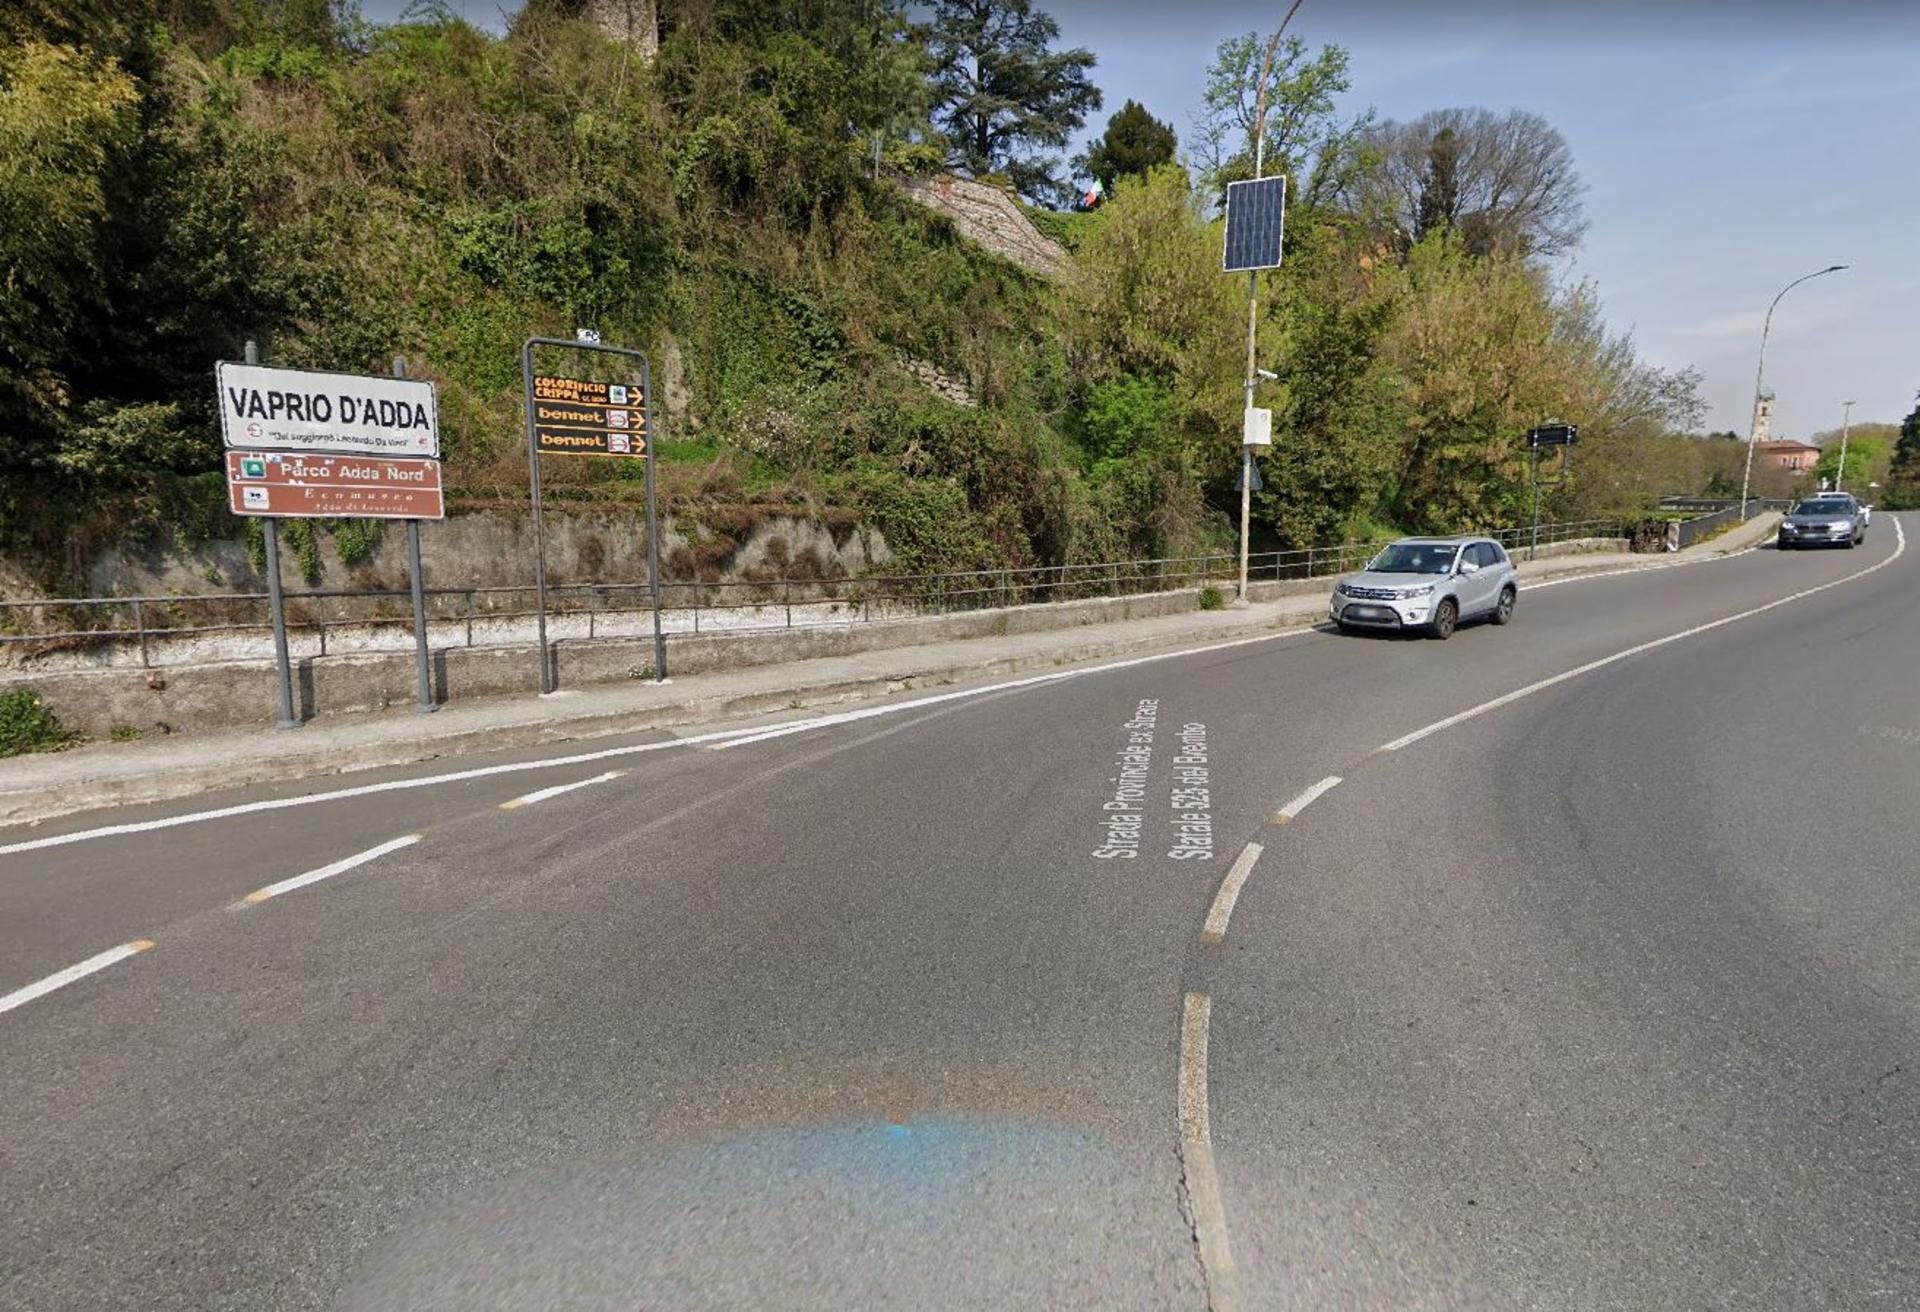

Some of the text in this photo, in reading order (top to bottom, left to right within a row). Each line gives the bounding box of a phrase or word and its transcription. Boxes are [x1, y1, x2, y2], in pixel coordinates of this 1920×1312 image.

[534, 377, 606, 394] COLORIFICIO
[535, 387, 580, 400] CRIPPA
[229, 387, 430, 430] VAPRIO D'ADDA
[538, 407, 605, 423] bennet
[541, 433, 606, 447] bennet
[281, 462, 424, 481] Parco Adda Nord
